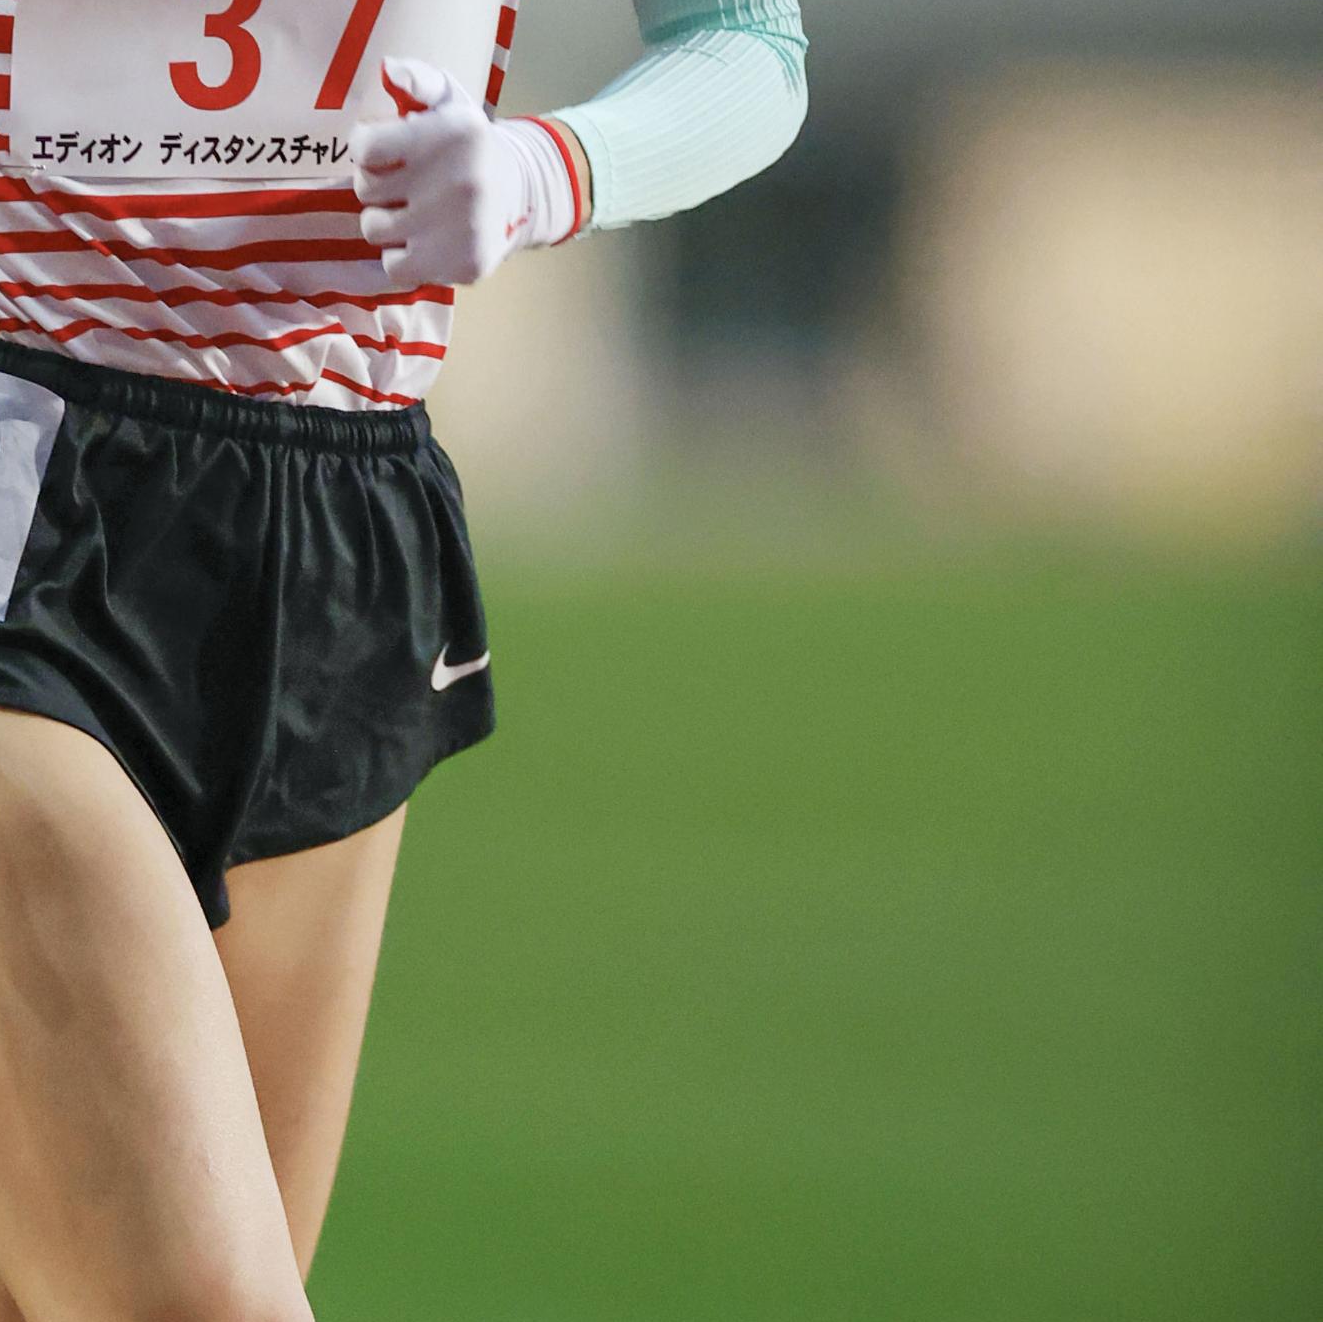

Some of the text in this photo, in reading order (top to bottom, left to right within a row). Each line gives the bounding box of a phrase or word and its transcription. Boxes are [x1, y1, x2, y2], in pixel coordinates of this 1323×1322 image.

[32, 131, 355, 165] エディオン ディスタンスチャレ
